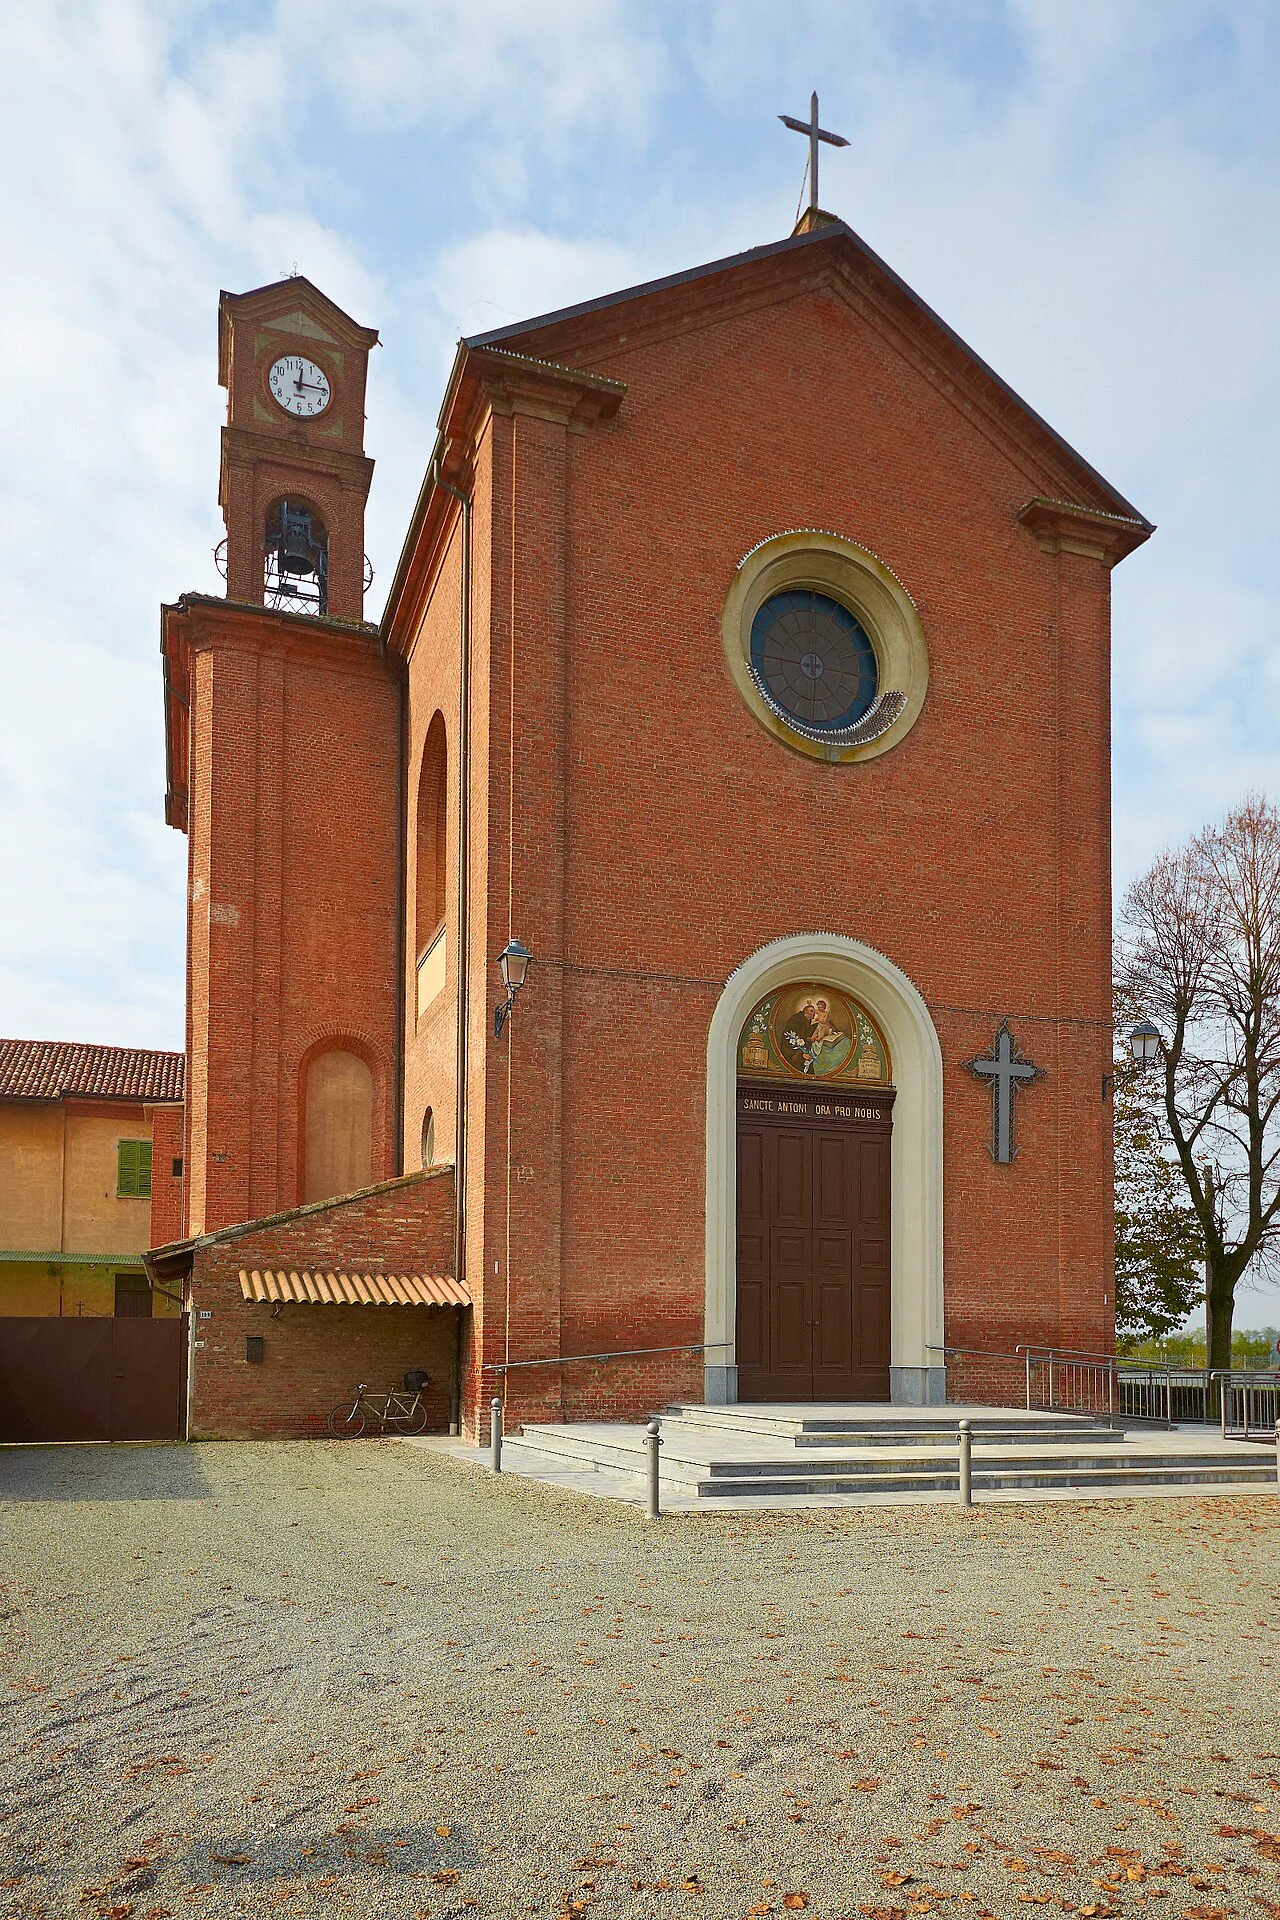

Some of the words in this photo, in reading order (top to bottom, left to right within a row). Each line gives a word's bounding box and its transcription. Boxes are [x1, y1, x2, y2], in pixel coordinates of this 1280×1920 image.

[286, 360, 293, 371] 11
[295, 360, 304, 371] 12
[276, 366, 285, 376] 10
[272, 375, 278, 385] 9
[316, 375, 322, 385] 2
[277, 388, 283, 397] 8
[286, 397, 291, 406] 7
[296, 402, 302, 411] 6
[307, 402, 313, 411] 5
[316, 397, 322, 406] 4
[743, 1098, 774, 1112] SANCTE
[777, 1101, 807, 1113] ANTONI
[815, 1104, 831, 1115] ORA
[834, 1105, 851, 1117] PRO
[854, 1107, 881, 1120] NOBIS
